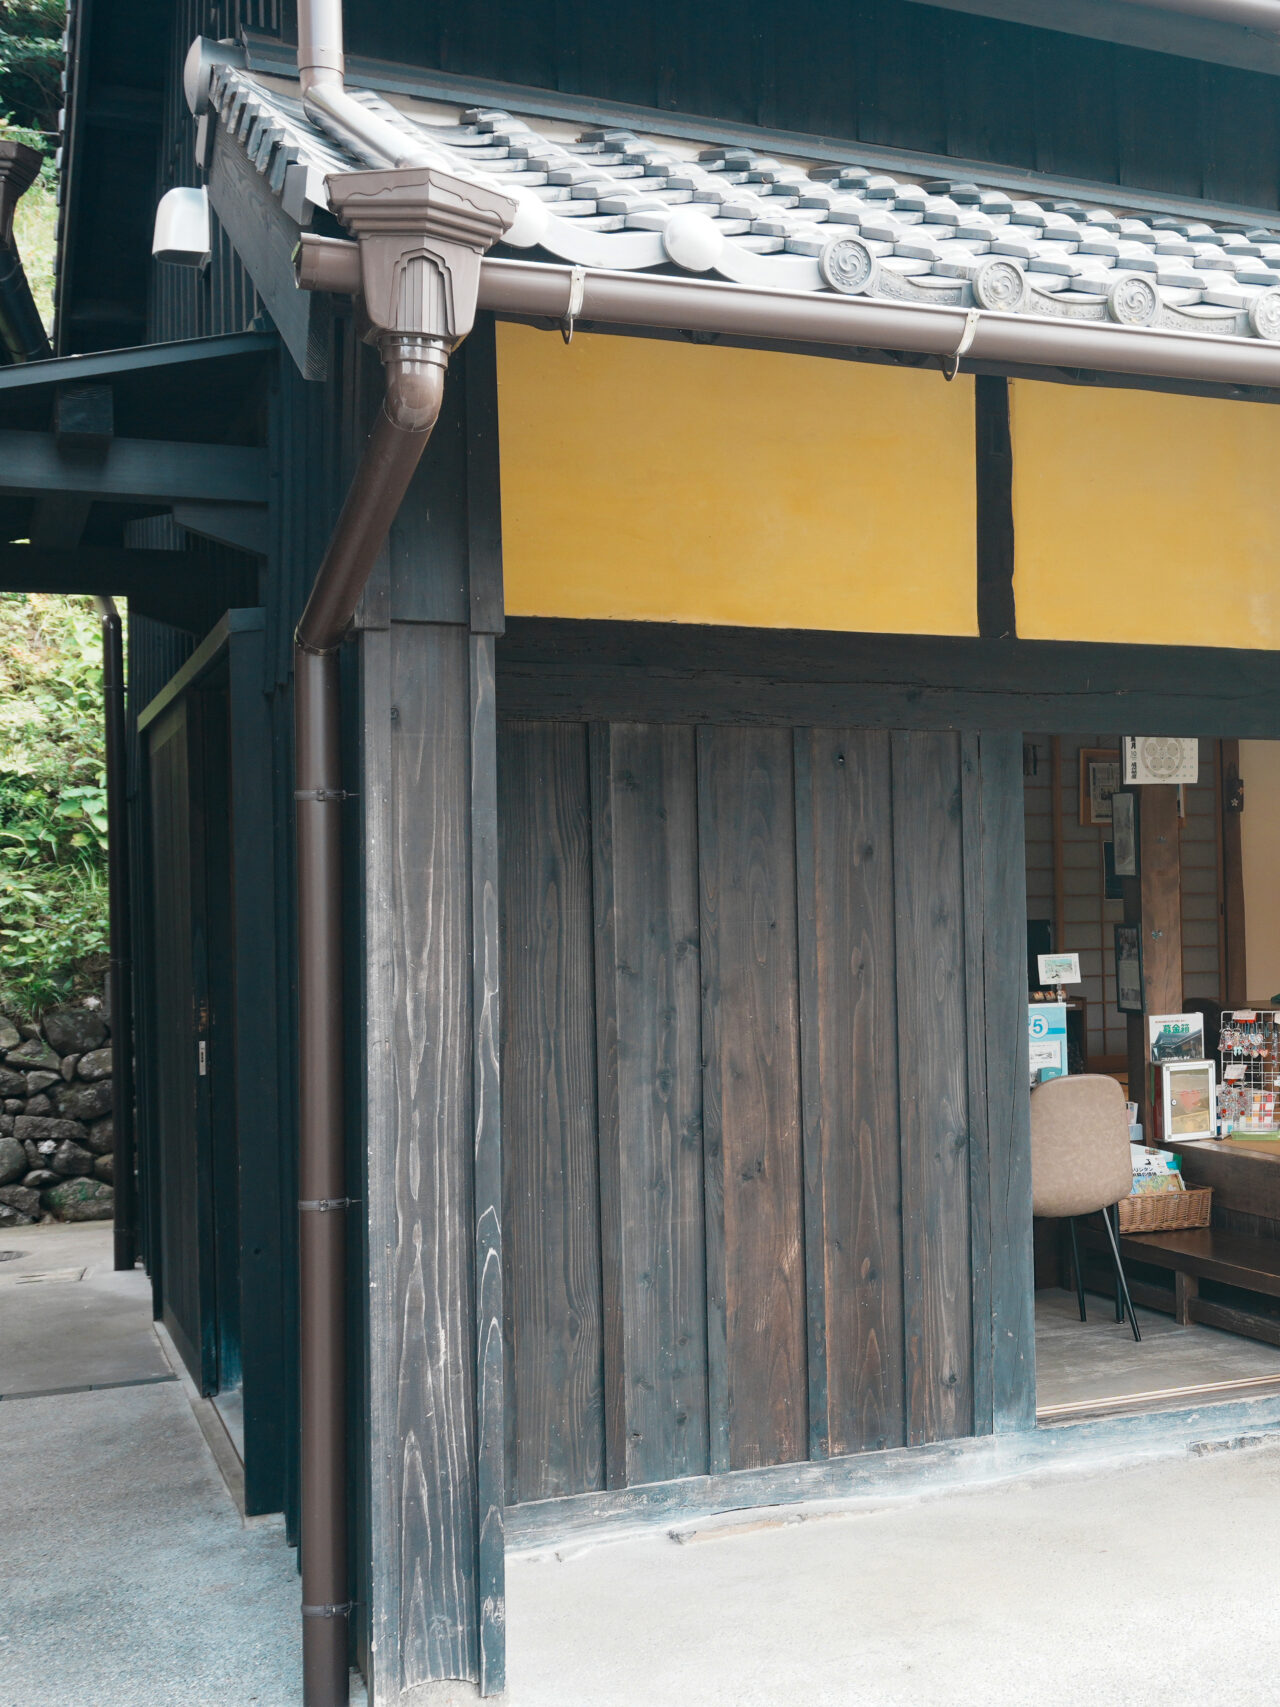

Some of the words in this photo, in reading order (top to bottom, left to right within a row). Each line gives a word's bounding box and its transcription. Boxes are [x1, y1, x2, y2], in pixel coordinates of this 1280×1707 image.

[1033, 1018, 1043, 1035] 5
[1162, 1023, 1190, 1034] 募金箱
